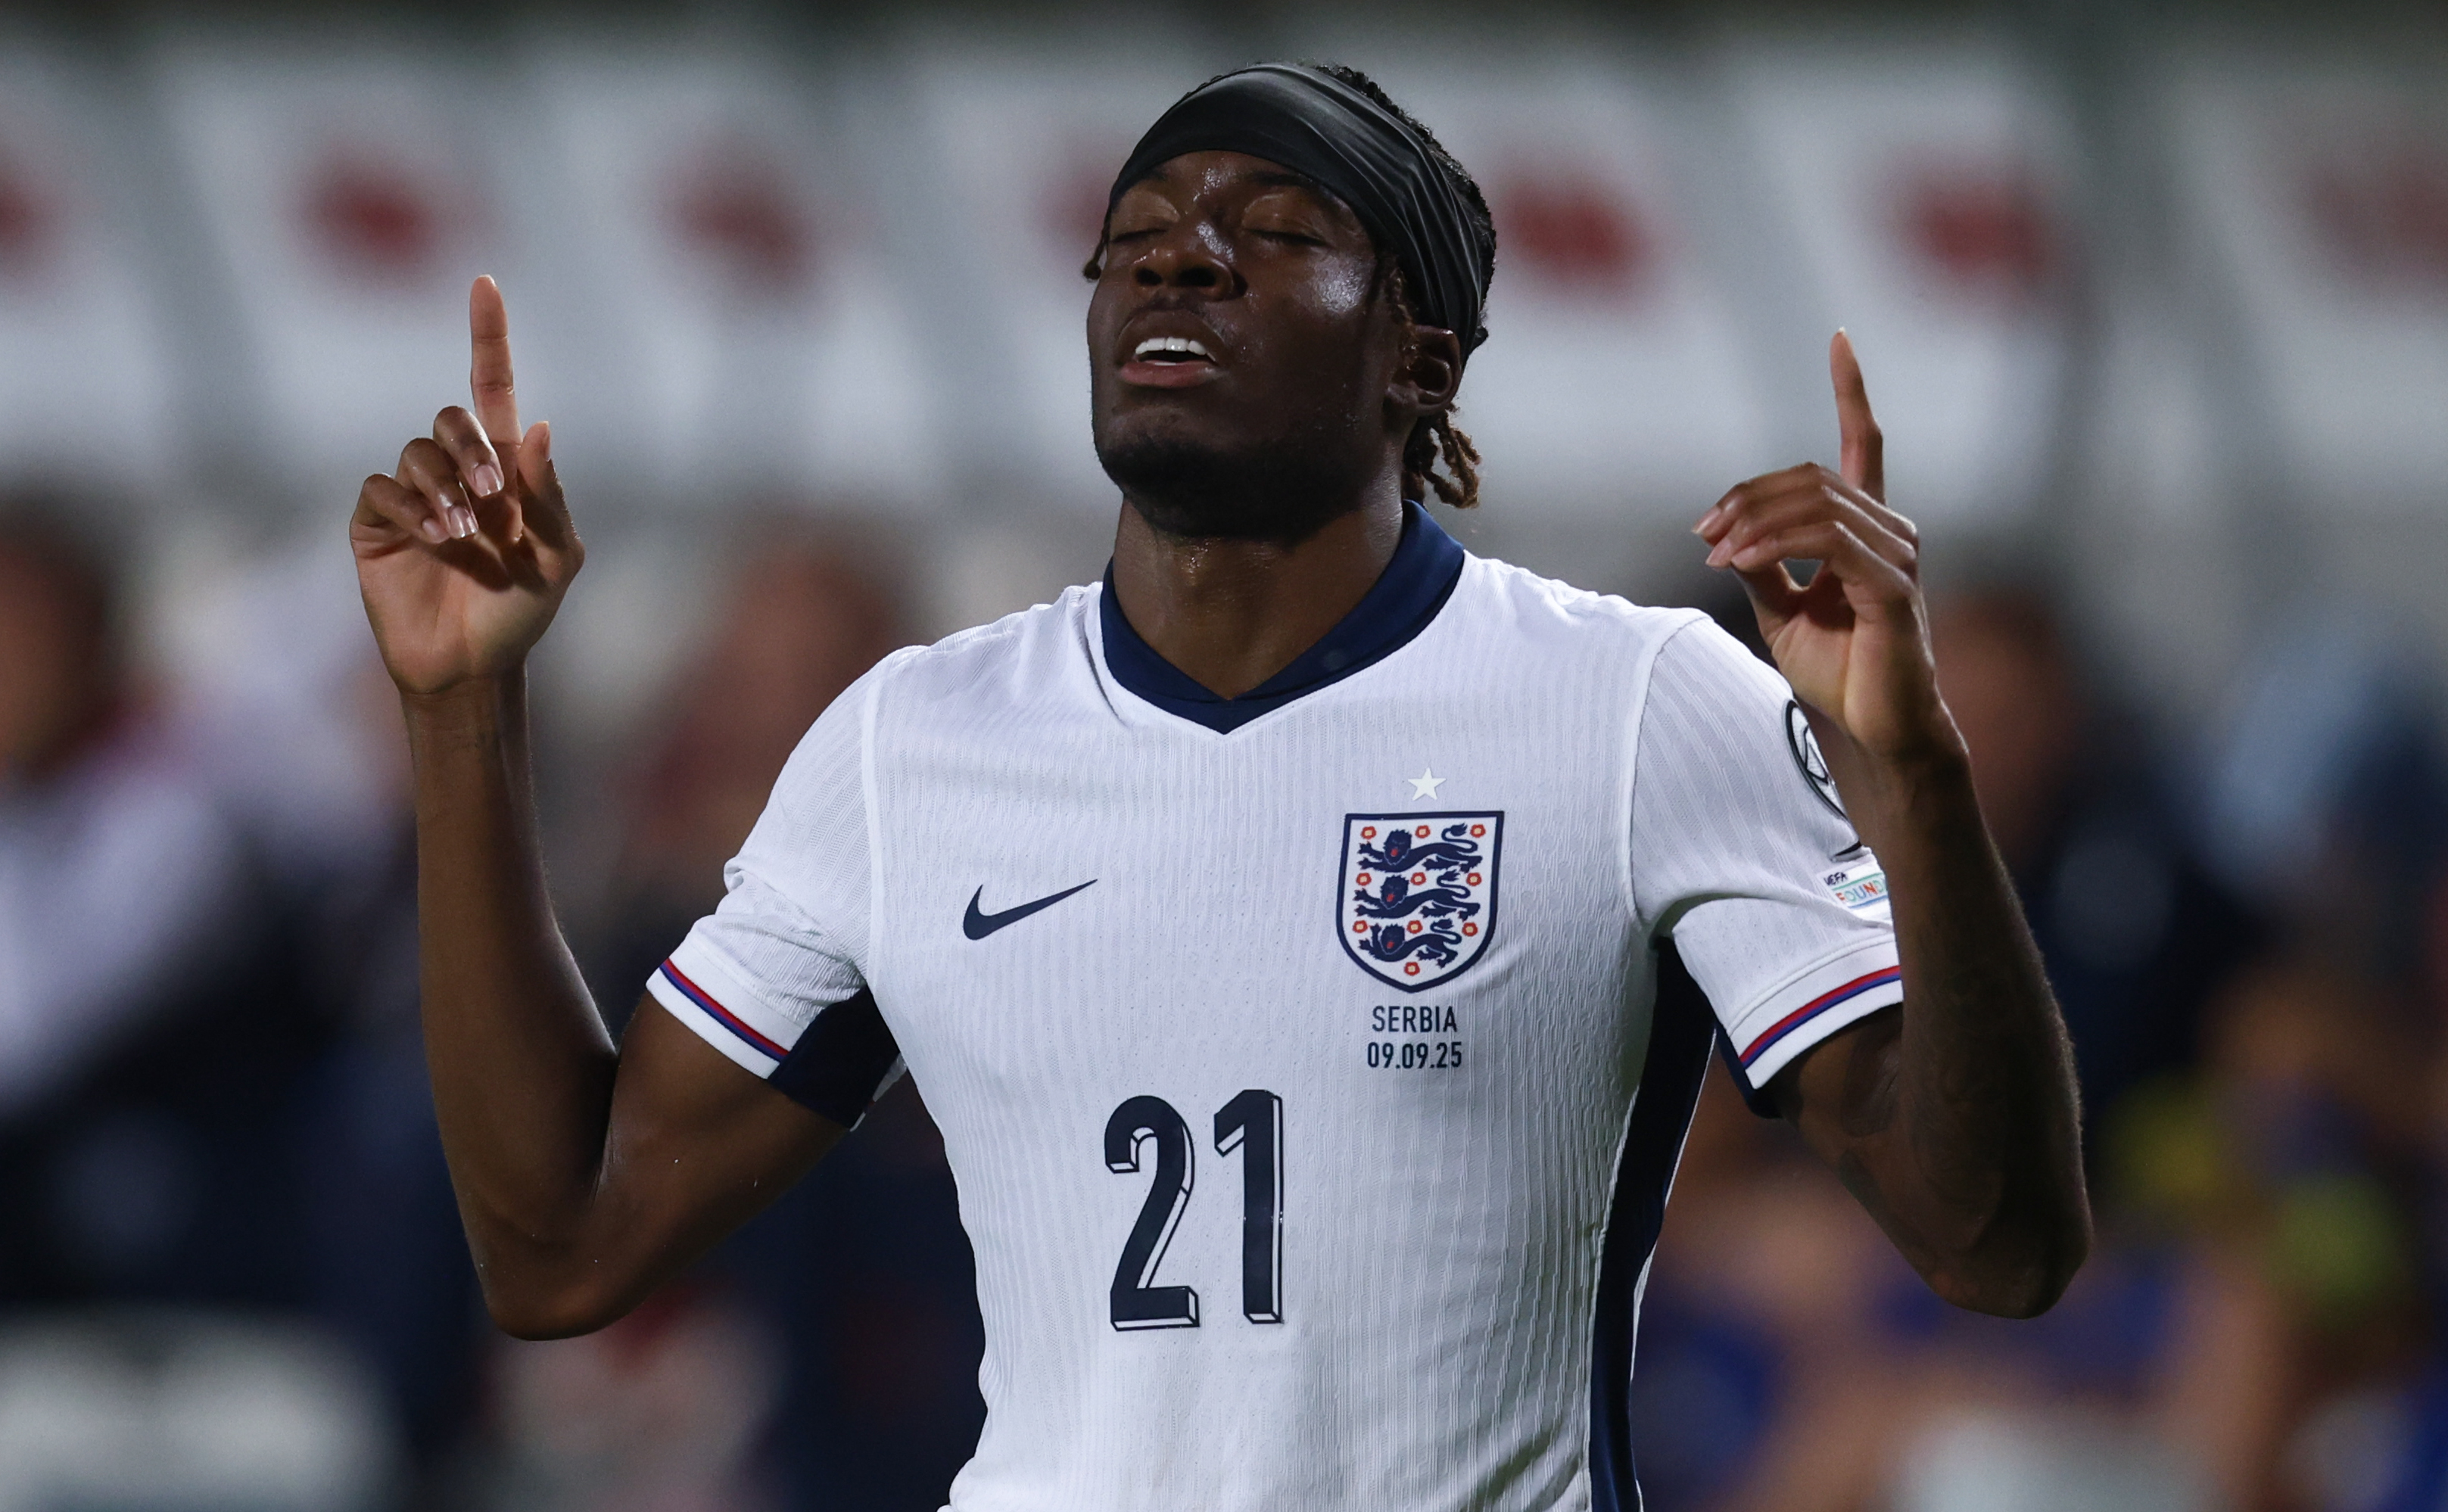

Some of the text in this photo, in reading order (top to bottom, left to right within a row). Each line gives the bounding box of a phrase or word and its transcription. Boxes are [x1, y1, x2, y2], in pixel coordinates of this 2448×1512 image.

[1824, 872, 1847, 885] UEFA
[1372, 1005, 1457, 1033] SERBIA
[1367, 1041, 1462, 1069] 09.09.25
[1104, 1090, 1284, 1331] 21
